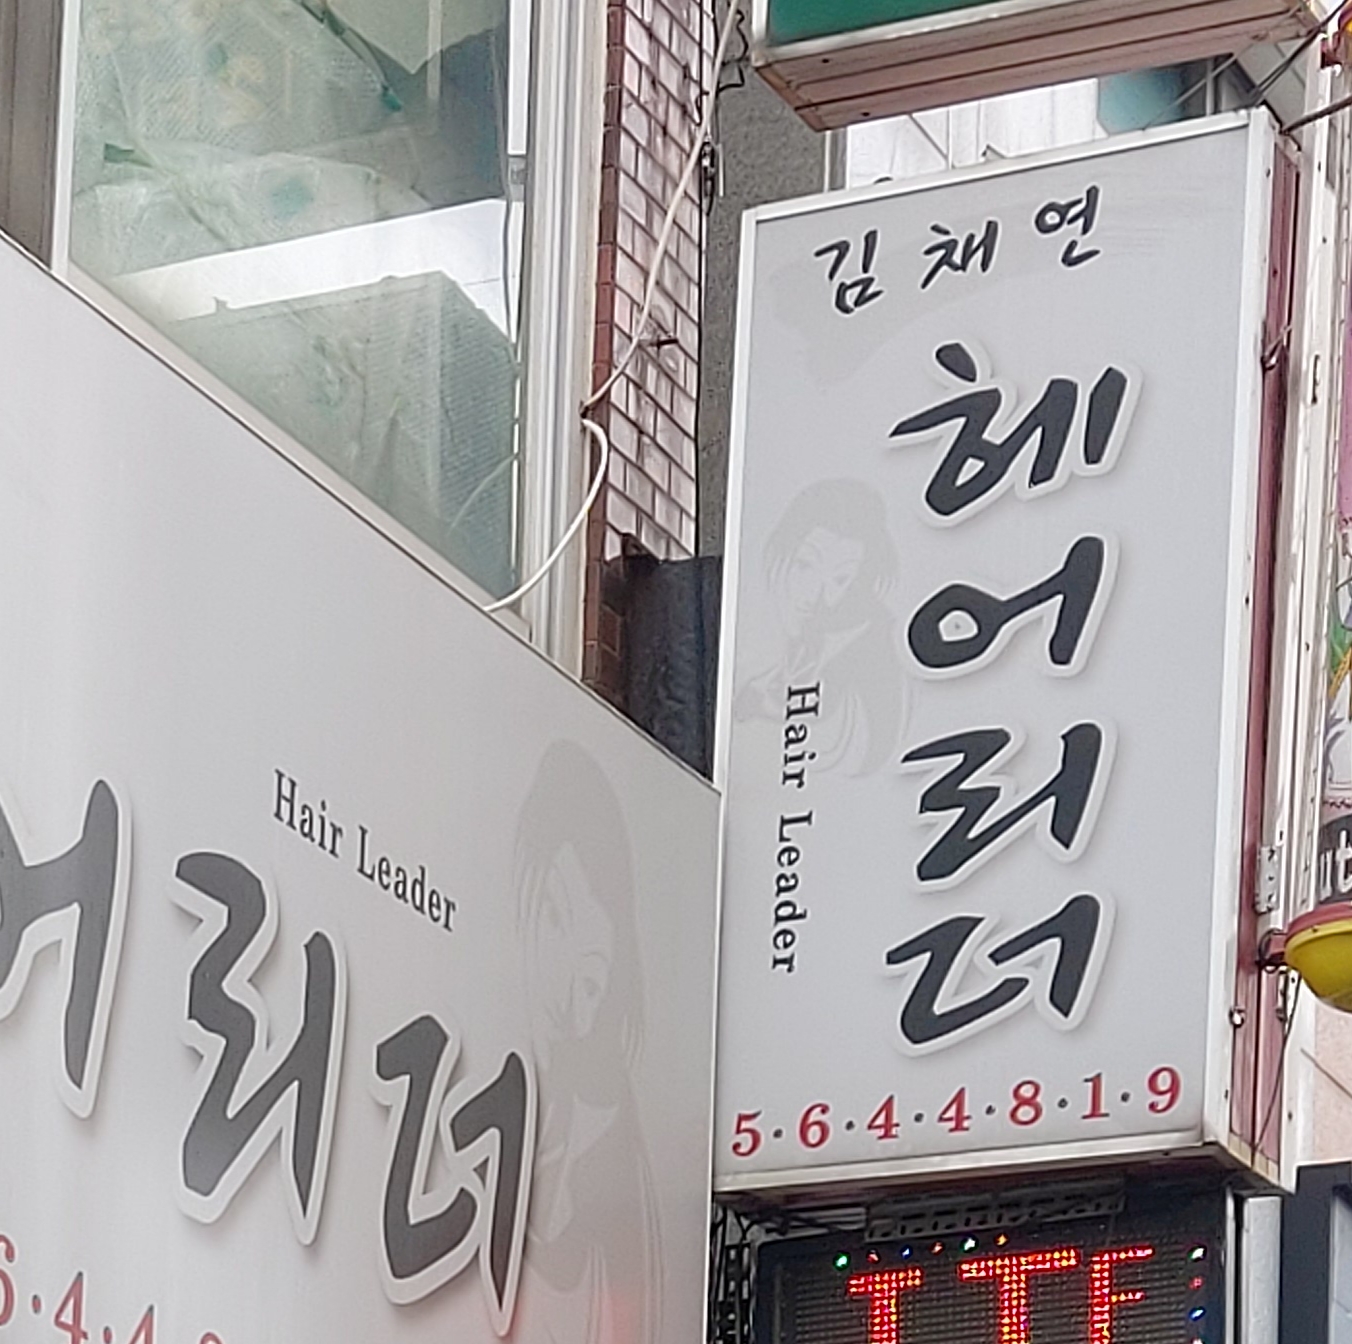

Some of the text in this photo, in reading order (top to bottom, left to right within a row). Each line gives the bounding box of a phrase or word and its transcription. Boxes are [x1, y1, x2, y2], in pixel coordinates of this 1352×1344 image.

[815, 185, 1101, 314] 김채연
[886, 341, 1128, 1045] 헤어리더
[273, 769, 456, 932] Hair Leader
[771, 681, 820, 973] Hair Leader
